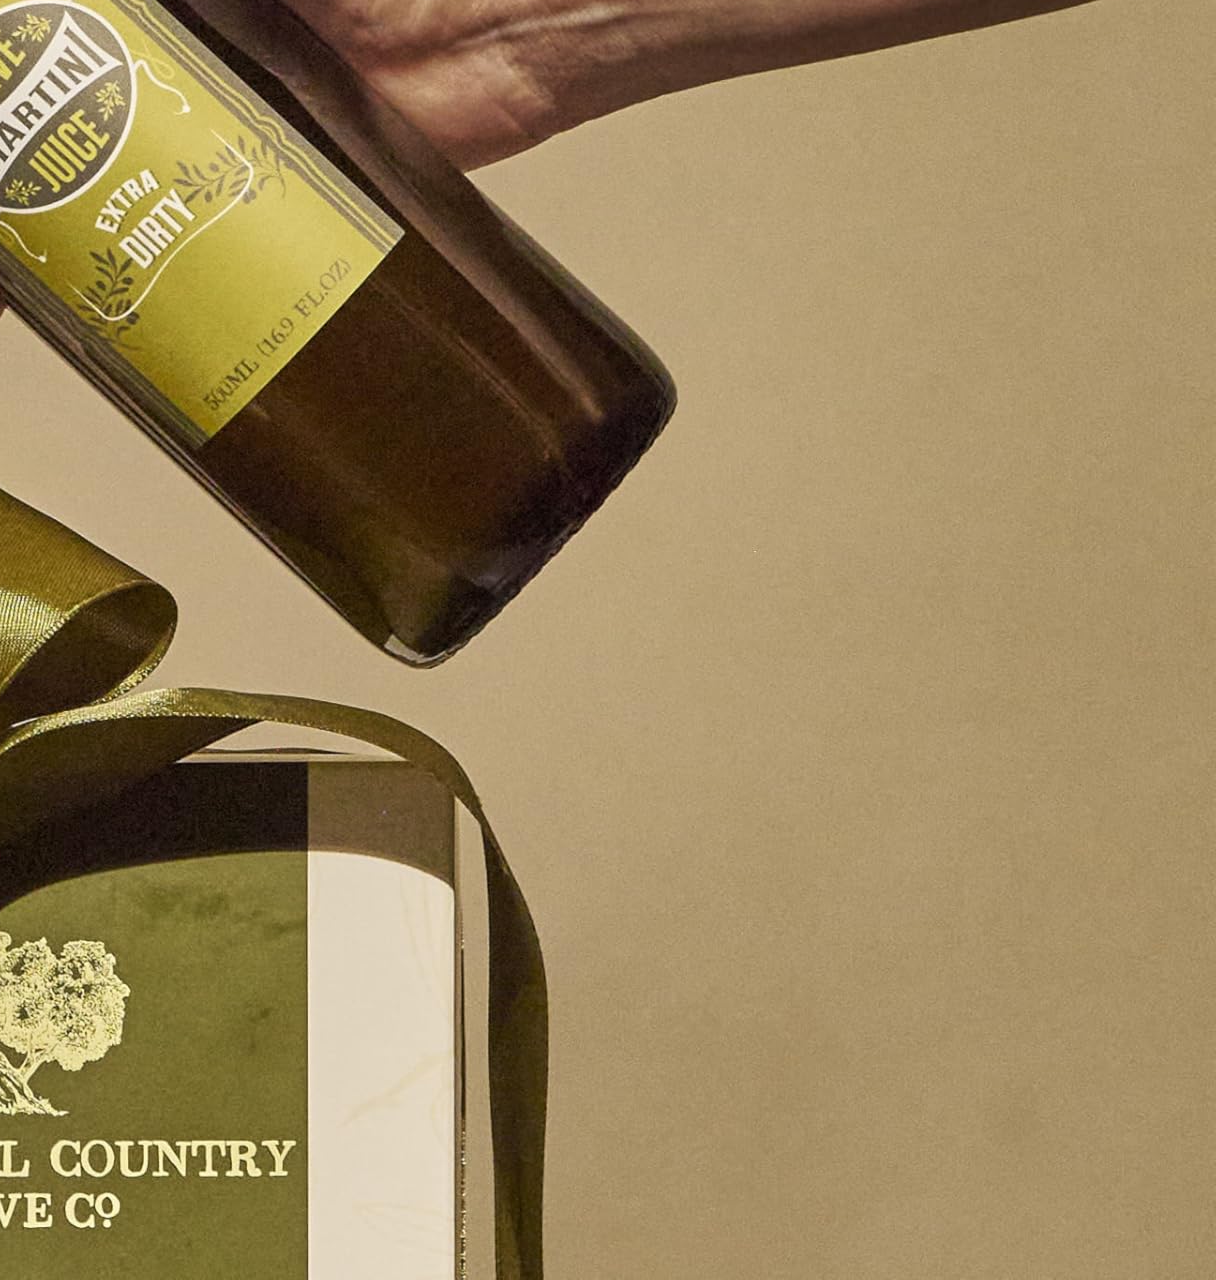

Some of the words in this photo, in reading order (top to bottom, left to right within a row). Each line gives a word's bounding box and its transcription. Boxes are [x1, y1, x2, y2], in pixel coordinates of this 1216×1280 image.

[29, 109, 111, 194] JUICE
[95, 168, 161, 235] EXTRA
[118, 188, 197, 270] DIRTY
[202, 358, 261, 412] 500ML
[49, 1139, 298, 1178] COUNTRY
